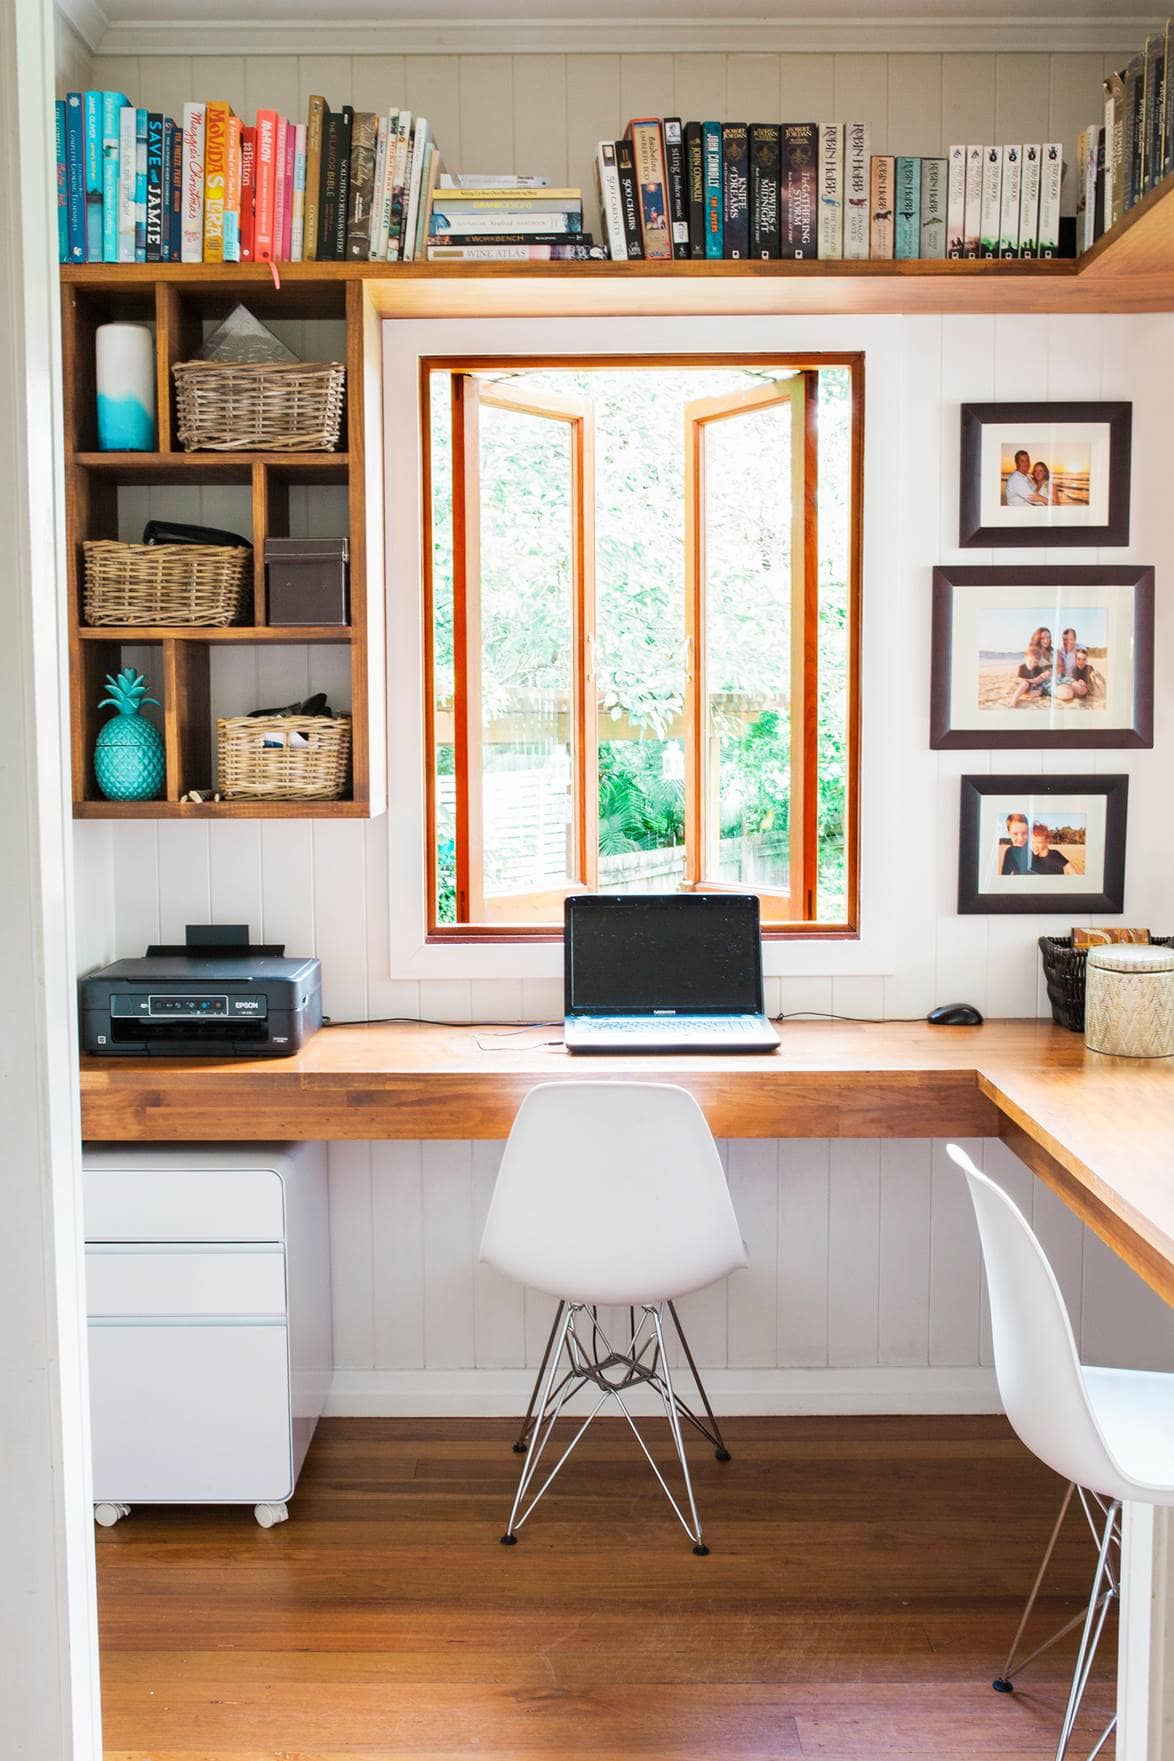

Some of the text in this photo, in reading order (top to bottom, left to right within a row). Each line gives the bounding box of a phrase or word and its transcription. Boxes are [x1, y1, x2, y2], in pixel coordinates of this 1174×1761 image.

[148, 121, 162, 166] SAVE
[670, 147, 682, 174] sting
[691, 147, 702, 166] JOHN
[707, 133, 720, 188] JOHN CONNOLLY
[823, 126, 837, 194] ROBIN HOBB
[850, 123, 864, 193] ROBIN HOBB
[188, 160, 203, 219] Christmas
[326, 171, 336, 198] BIBLE
[622, 178, 633, 198] 500
[693, 166, 703, 203] CONNOLLY
[877, 159, 887, 210] ROBIN HOBB
[903, 160, 913, 185] ROBIN
[928, 162, 939, 214] ROBIN HOBB
[675, 199, 683, 218] music
[730, 173, 738, 219] DREAMS
[738, 177, 747, 209] KNIFE
[760, 178, 769, 233] MIDNIGHT
[768, 180, 777, 232] TOWERS of
[793, 189, 802, 225] STORM
[801, 172, 810, 244] The GATHERING
[904, 186, 913, 211] HOBB
[71, 194, 79, 232] TECHNIQUES
[147, 184, 161, 244] JAMIE
[383, 198, 391, 229] SAUCES
[626, 198, 637, 231] CHAIRS
[466, 249, 527, 258] WINE ATLAS
[235, 1001, 258, 1009] EPSON
